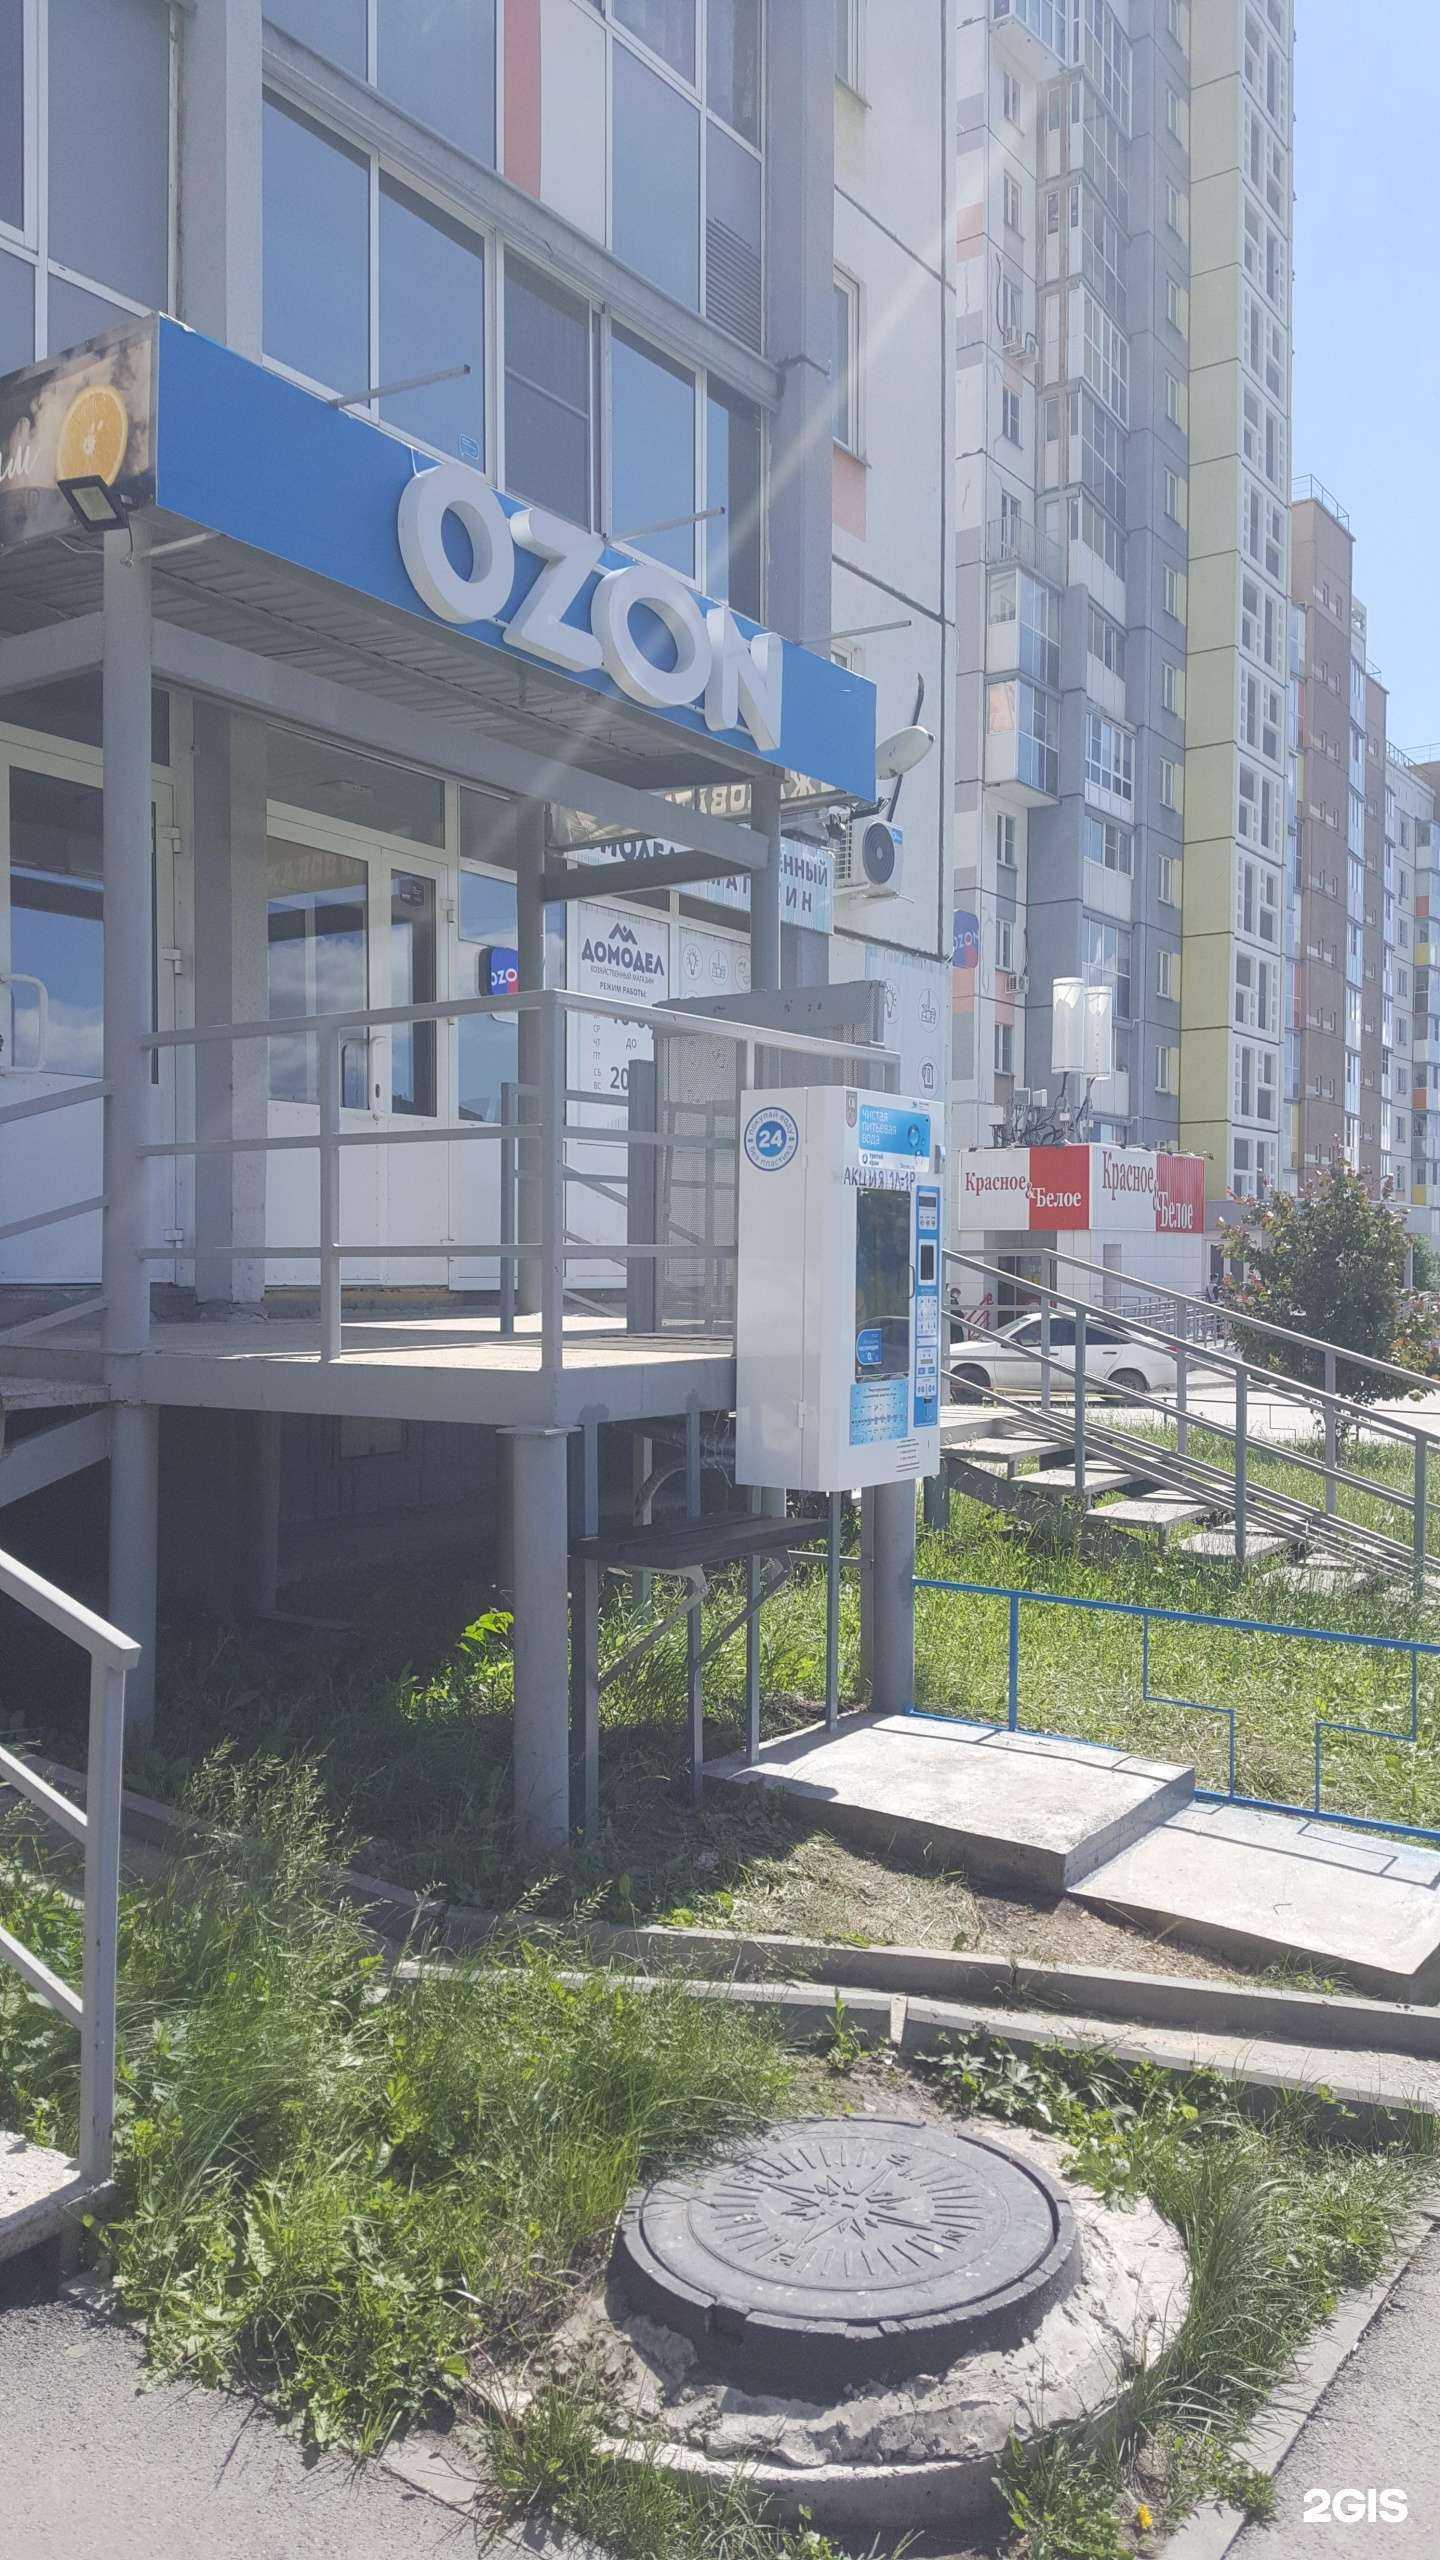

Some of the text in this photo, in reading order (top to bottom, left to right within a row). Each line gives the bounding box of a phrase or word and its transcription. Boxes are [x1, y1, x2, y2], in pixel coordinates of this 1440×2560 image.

[398, 463, 782, 751] OZON
[581, 938, 665, 976] ДОМОДЕЛ
[491, 968, 518, 986] OZO
[600, 981, 621, 993] РЕЖИМ
[759, 1129, 783, 1149] 24
[965, 1172, 1026, 1196] Красное
[1032, 1187, 1082, 1207] Белое
[1102, 1151, 1154, 1200] Красное
[1157, 1191, 1194, 1230] Белое
